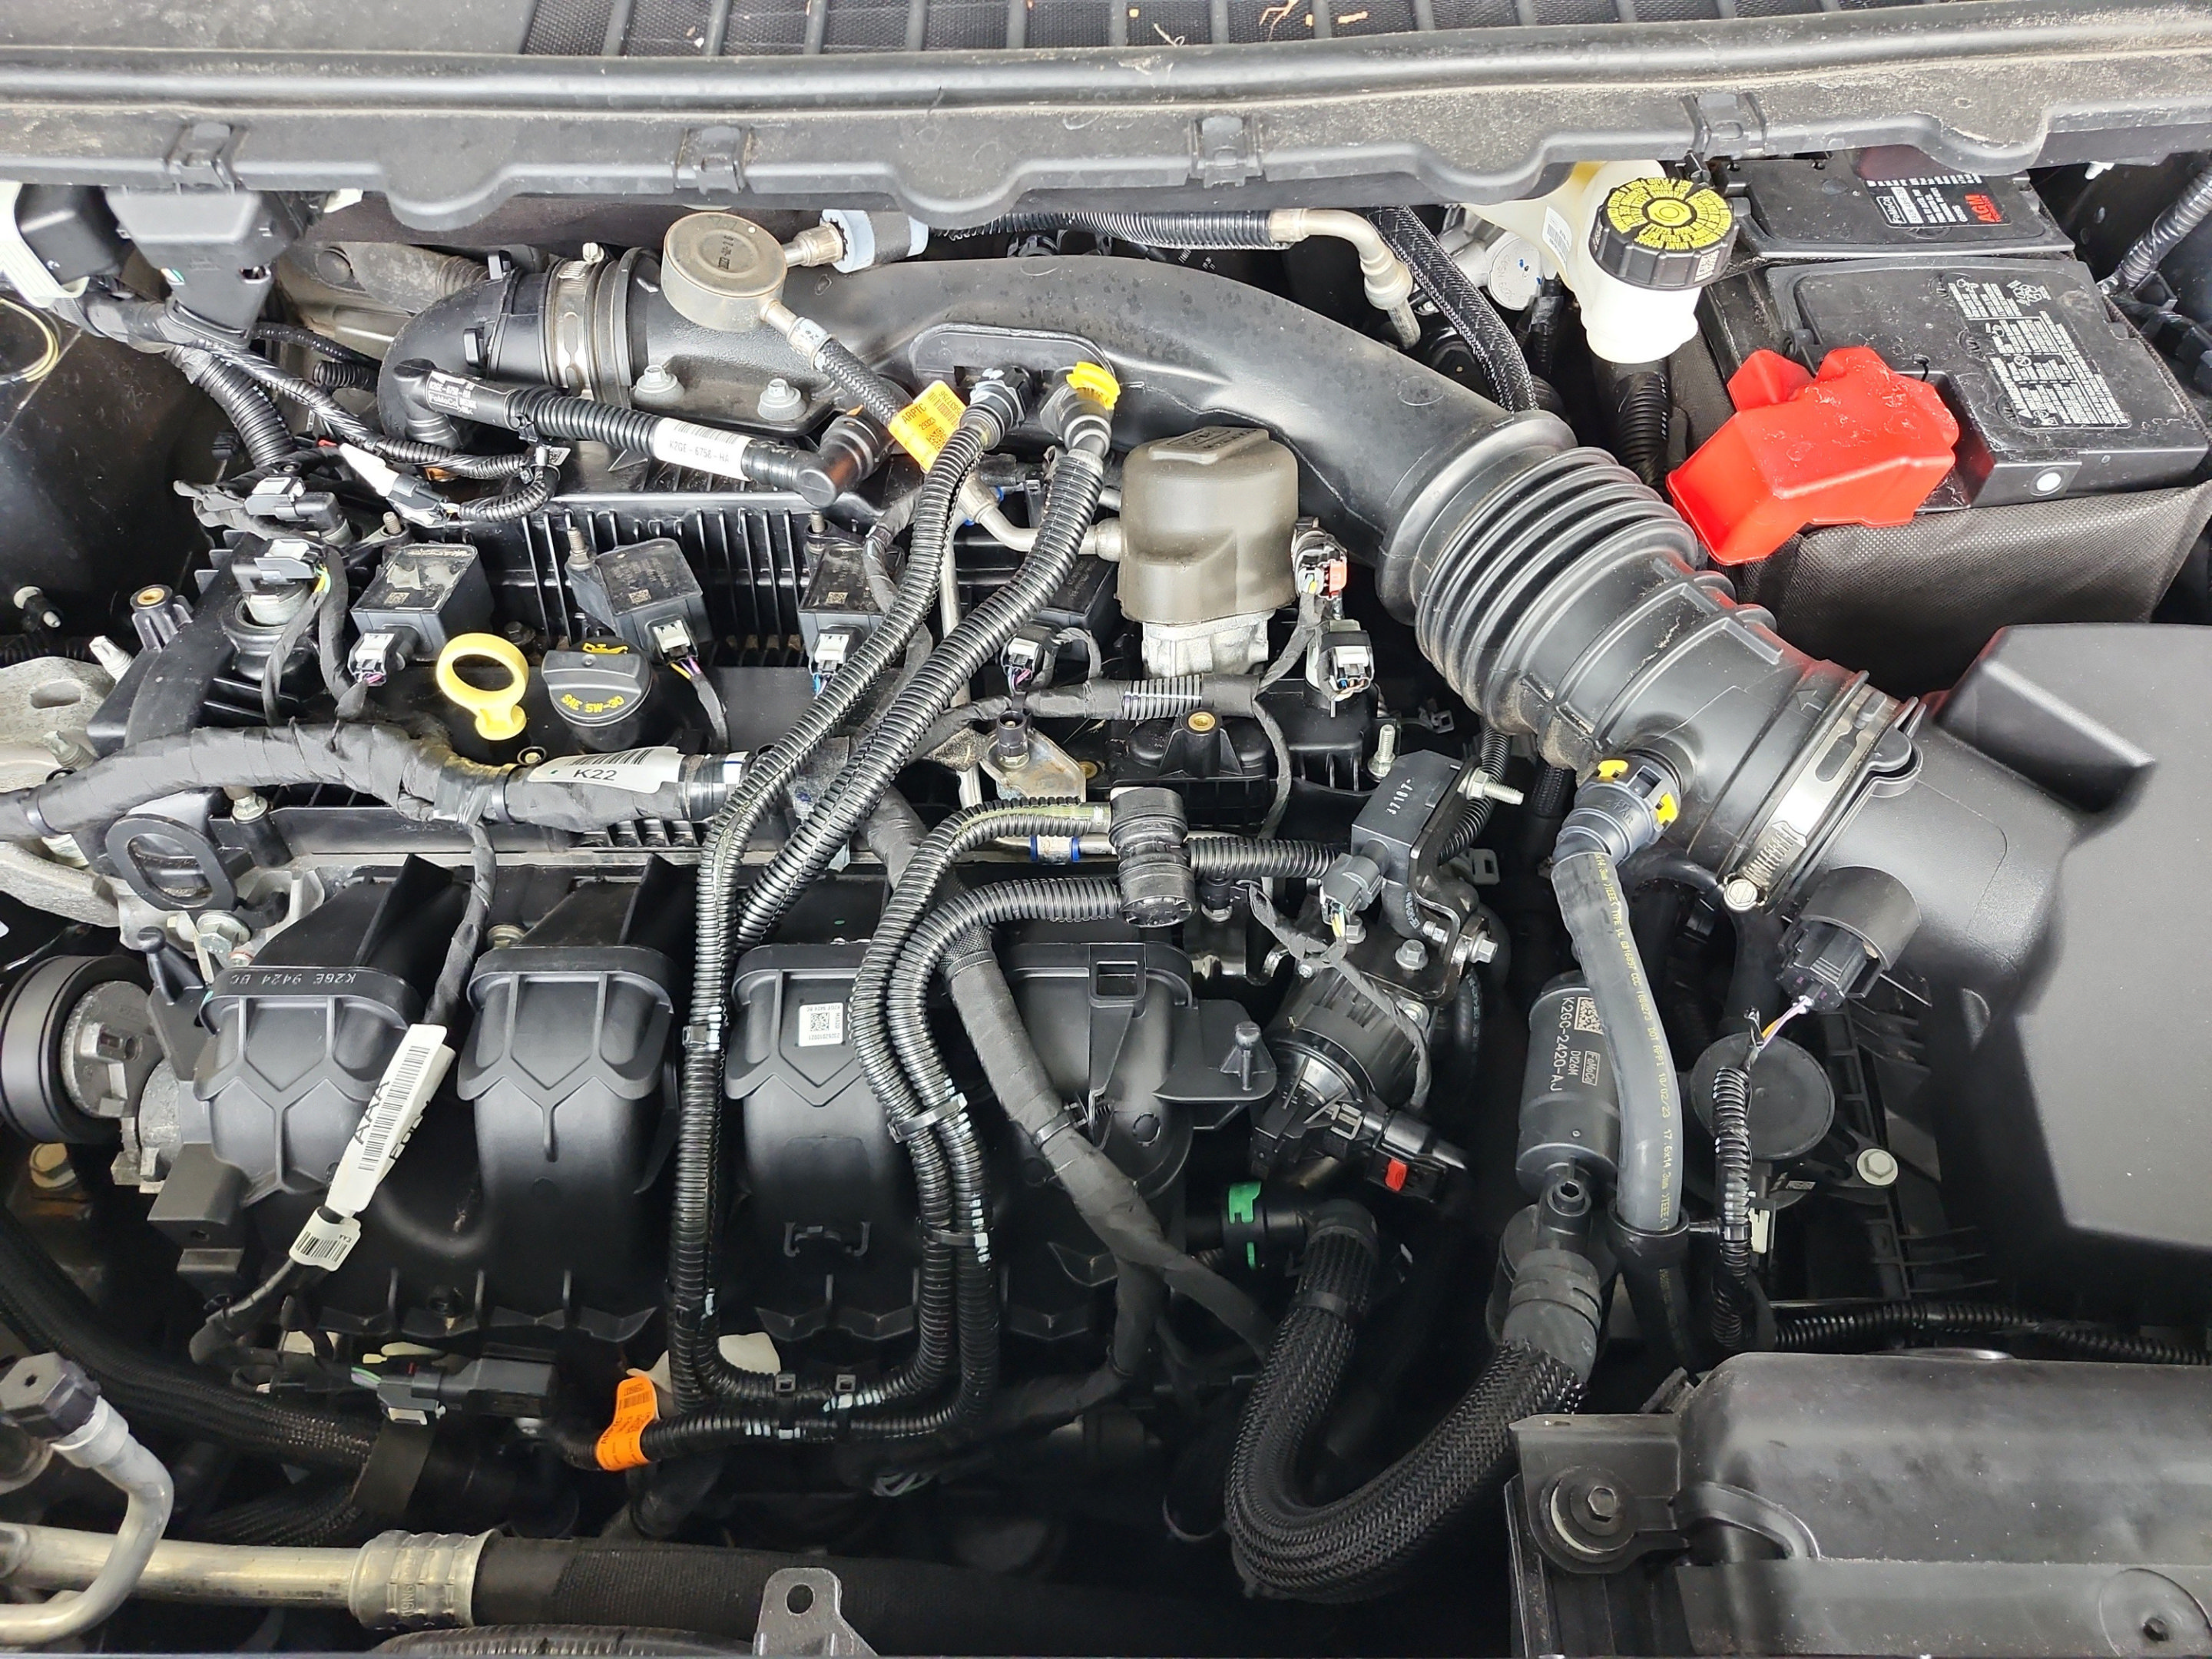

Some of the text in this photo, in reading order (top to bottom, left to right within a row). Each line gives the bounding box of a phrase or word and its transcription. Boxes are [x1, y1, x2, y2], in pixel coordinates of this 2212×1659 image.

[1882, 197, 1902, 223] FoMoCo
[1965, 194, 1997, 223] AGM
[902, 402, 927, 424] ARPTC
[561, 694, 625, 713] SAE 5W-30
[573, 769, 618, 781] K22
[261, 973, 303, 985] 9424
[313, 972, 357, 985] K2GE
[1612, 907, 1623, 926] TYPE
[1630, 971, 1641, 987] CCC
[1647, 1026, 1659, 1044] DOT
[1658, 1072, 1670, 1119] 10/02/23
[1550, 997, 1575, 1091] K2GC-2420-AJ
[1584, 1051, 1598, 1084] FoMoCo
[354, 1081, 390, 1145] AAA
[339, 1233, 352, 1243] EAA
